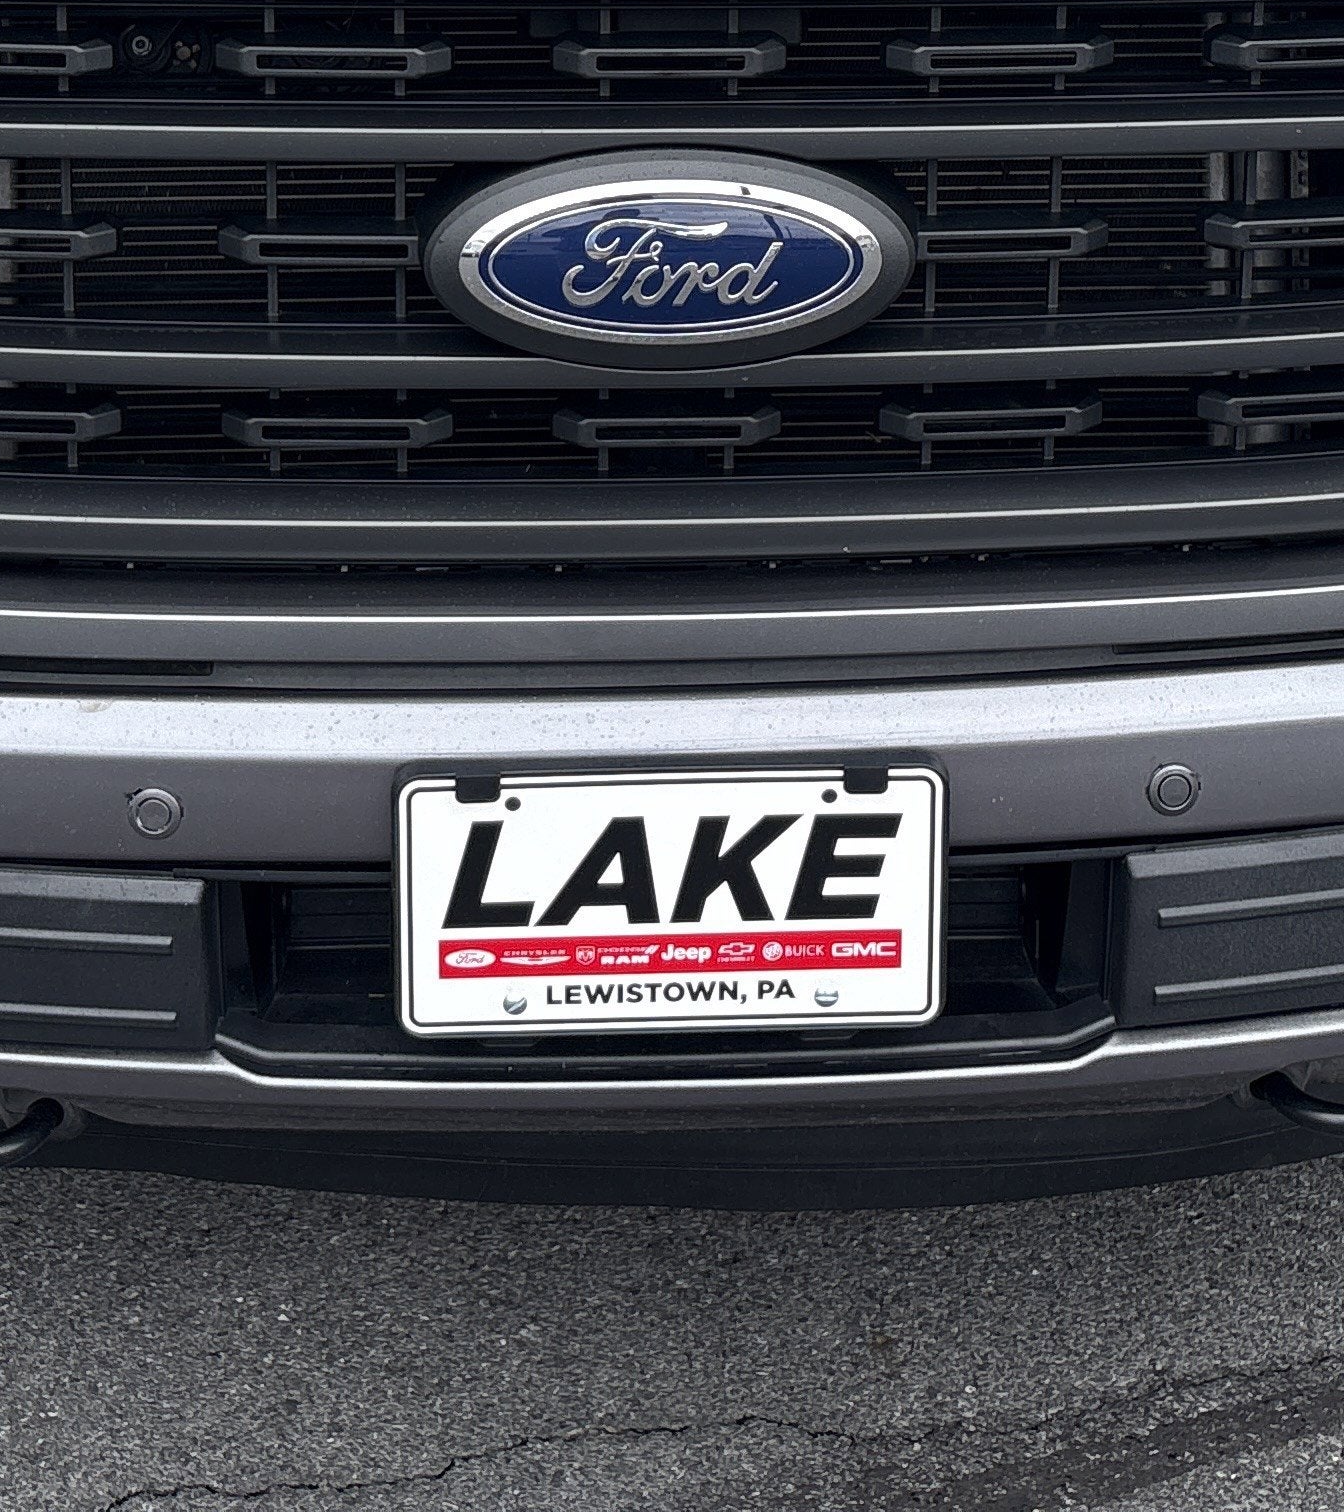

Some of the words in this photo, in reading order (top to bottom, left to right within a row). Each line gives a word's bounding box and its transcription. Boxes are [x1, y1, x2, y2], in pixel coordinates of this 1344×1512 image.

[561, 219, 784, 308] Ford
[441, 812, 903, 930] LAKE
[456, 951, 485, 965] Ford
[660, 943, 712, 964] Jeep
[785, 944, 825, 958] BUICK
[831, 941, 897, 958] GMC
[600, 954, 650, 965] RAM
[545, 981, 748, 1006] LEWISTOWN,
[757, 979, 796, 1001] PA
